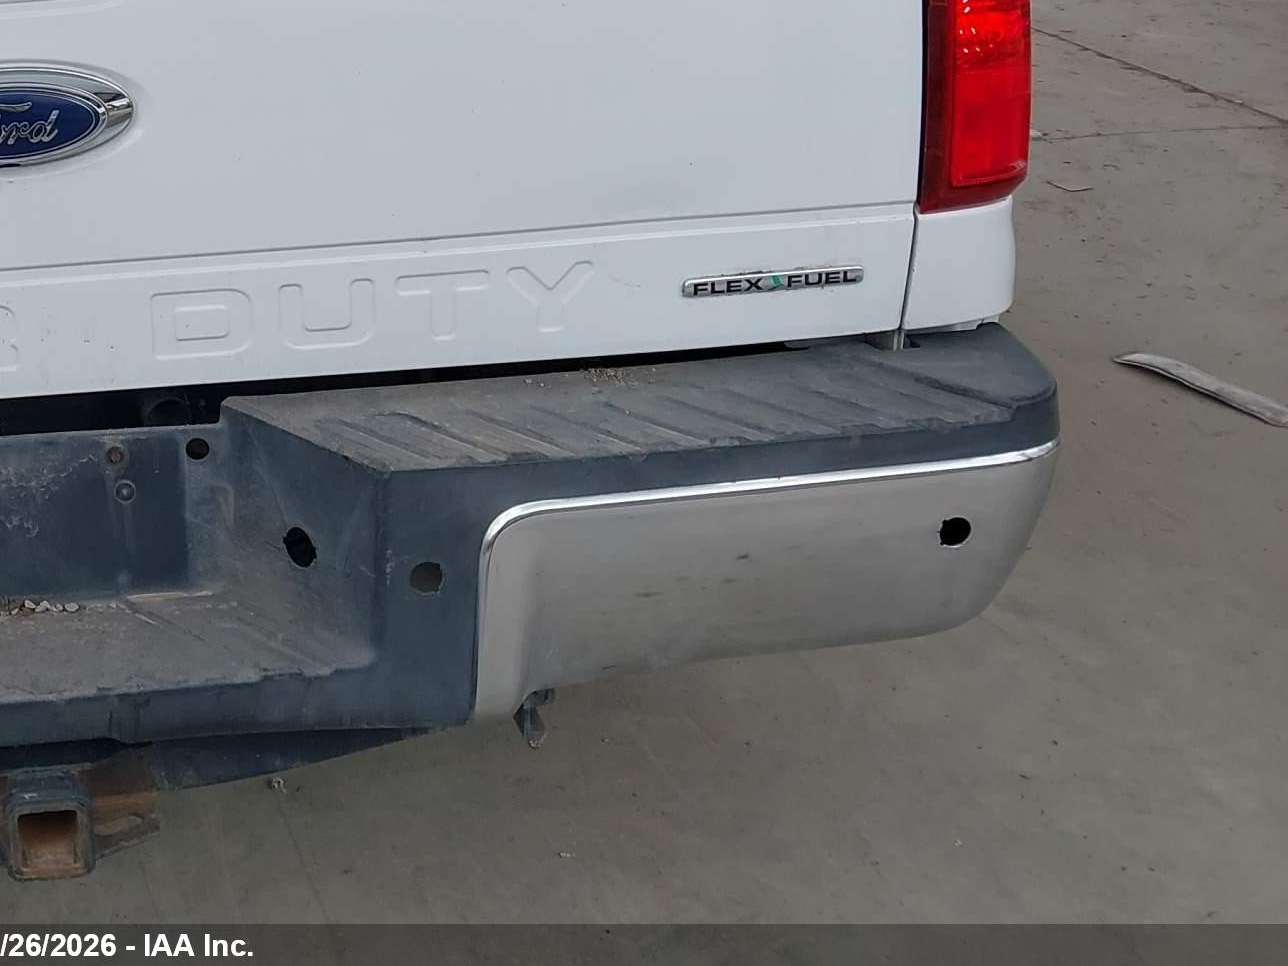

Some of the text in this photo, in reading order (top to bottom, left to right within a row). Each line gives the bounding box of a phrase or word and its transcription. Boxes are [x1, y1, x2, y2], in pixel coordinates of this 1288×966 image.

[150, 260, 595, 360] DUTY
[693, 270, 857, 296] FLEX FUEL
